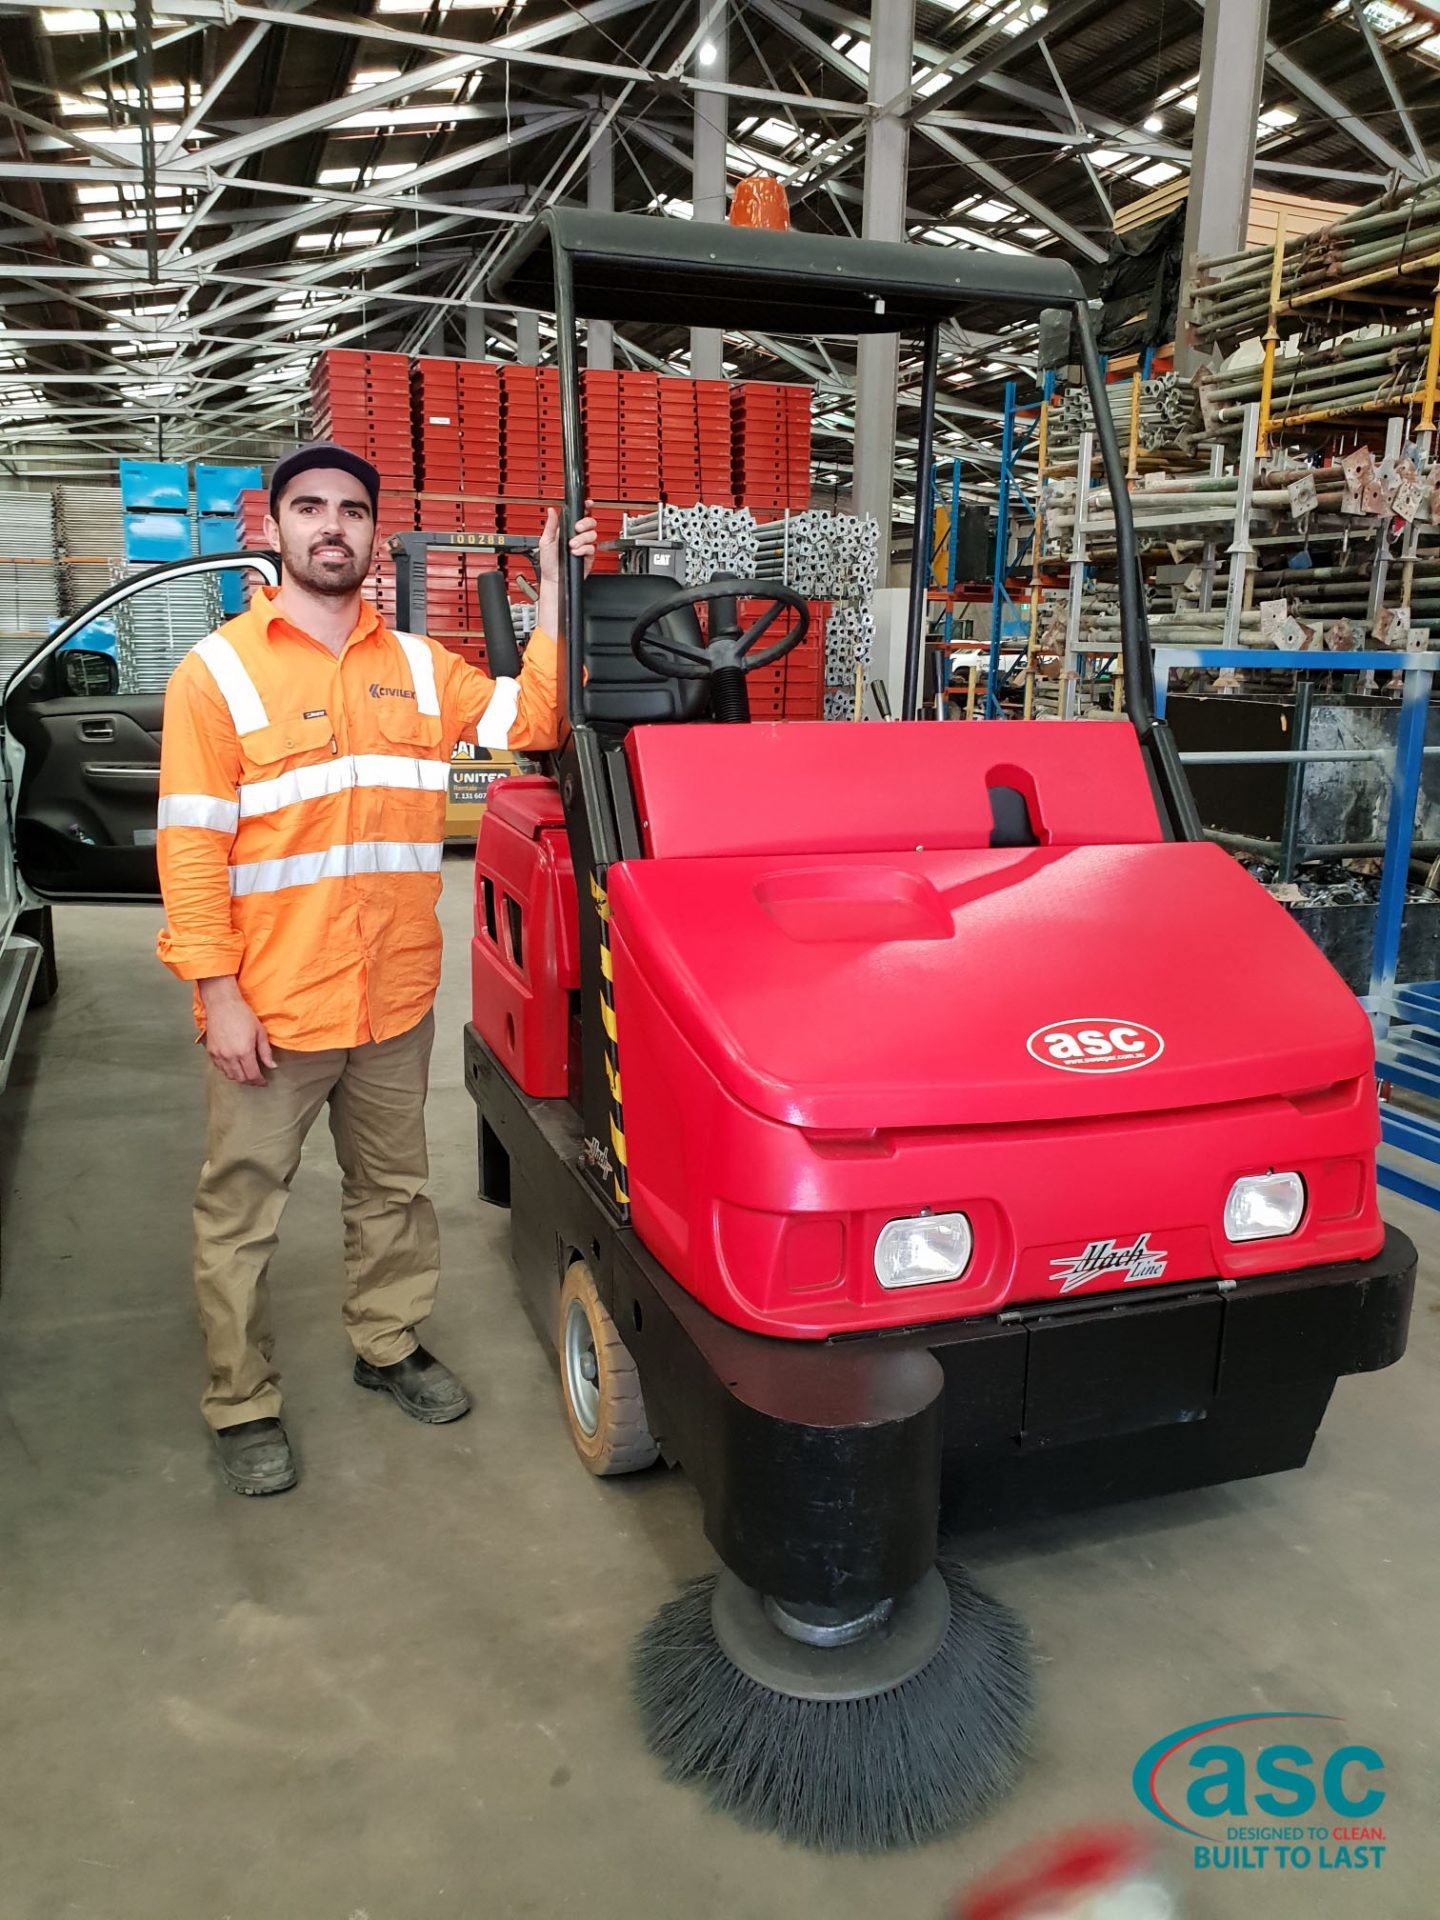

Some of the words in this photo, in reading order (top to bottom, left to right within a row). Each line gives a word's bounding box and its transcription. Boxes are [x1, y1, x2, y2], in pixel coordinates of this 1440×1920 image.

[450, 534, 505, 545] 100288
[653, 553, 671, 566] CAT
[379, 687, 416, 700] CIVILEX
[1044, 1027, 1146, 1059] asc
[1073, 1235, 1146, 1274] Mach
[1130, 1261, 1163, 1278] Line
